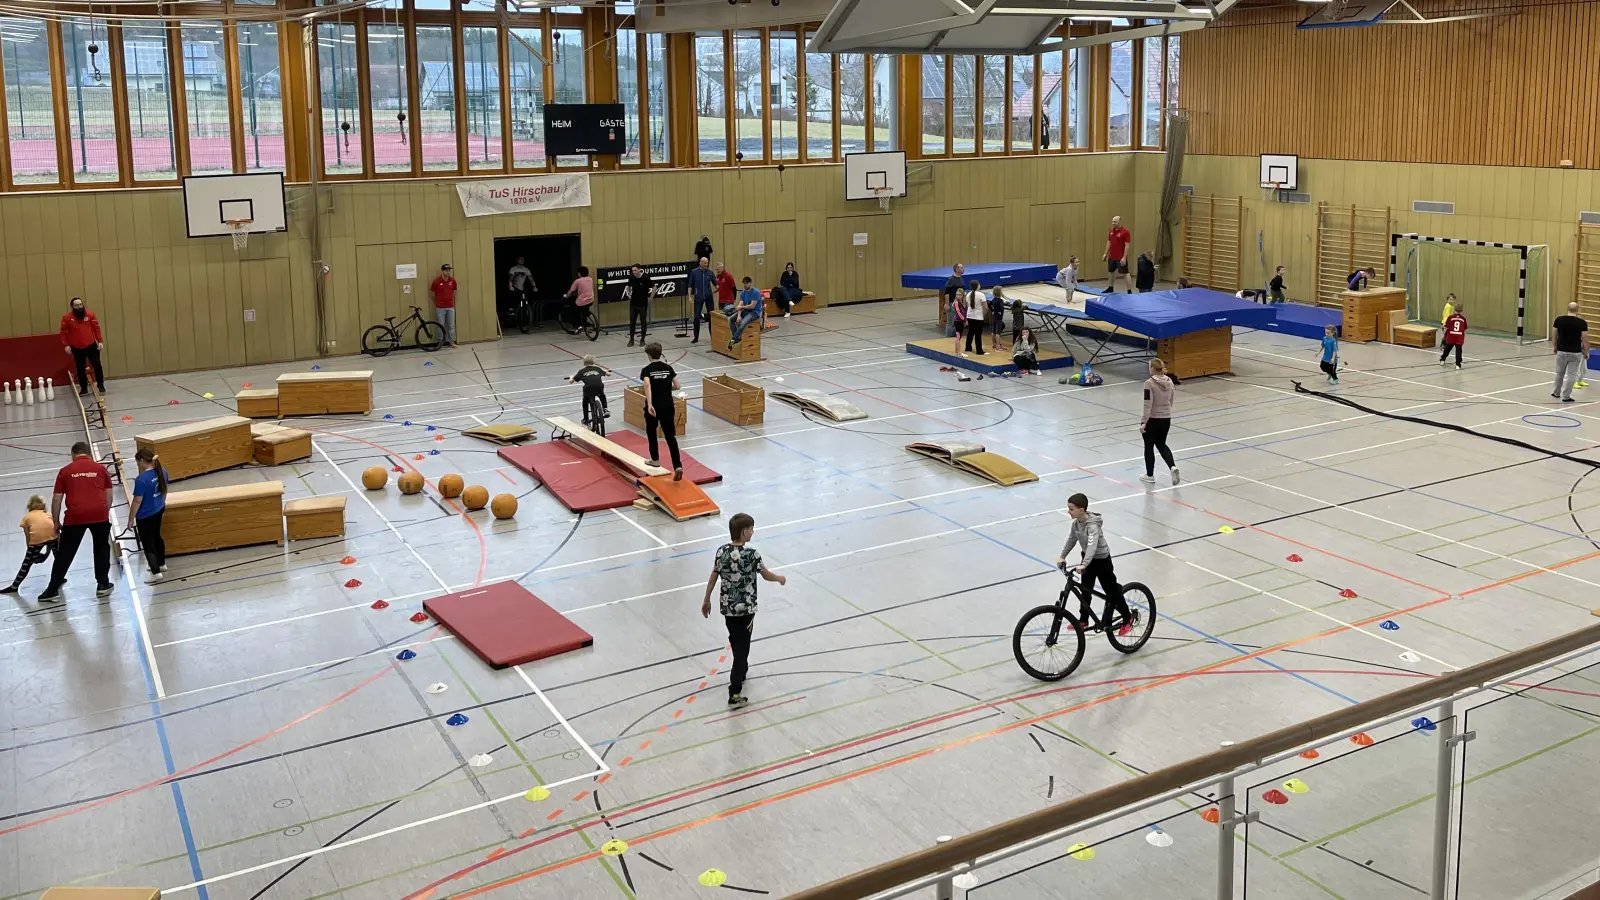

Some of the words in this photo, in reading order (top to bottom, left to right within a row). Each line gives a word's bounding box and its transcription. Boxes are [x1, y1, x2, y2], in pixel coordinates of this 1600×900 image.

[551, 120, 572, 128] HEIM
[599, 118, 625, 127] GÄSTE
[488, 187, 510, 199] TuS
[512, 185, 560, 197] Hirschau
[510, 197, 527, 205] 1870
[607, 269, 631, 278] WHITE
[640, 266, 669, 275] OUNTAIN
[1453, 321, 1460, 331] 9
